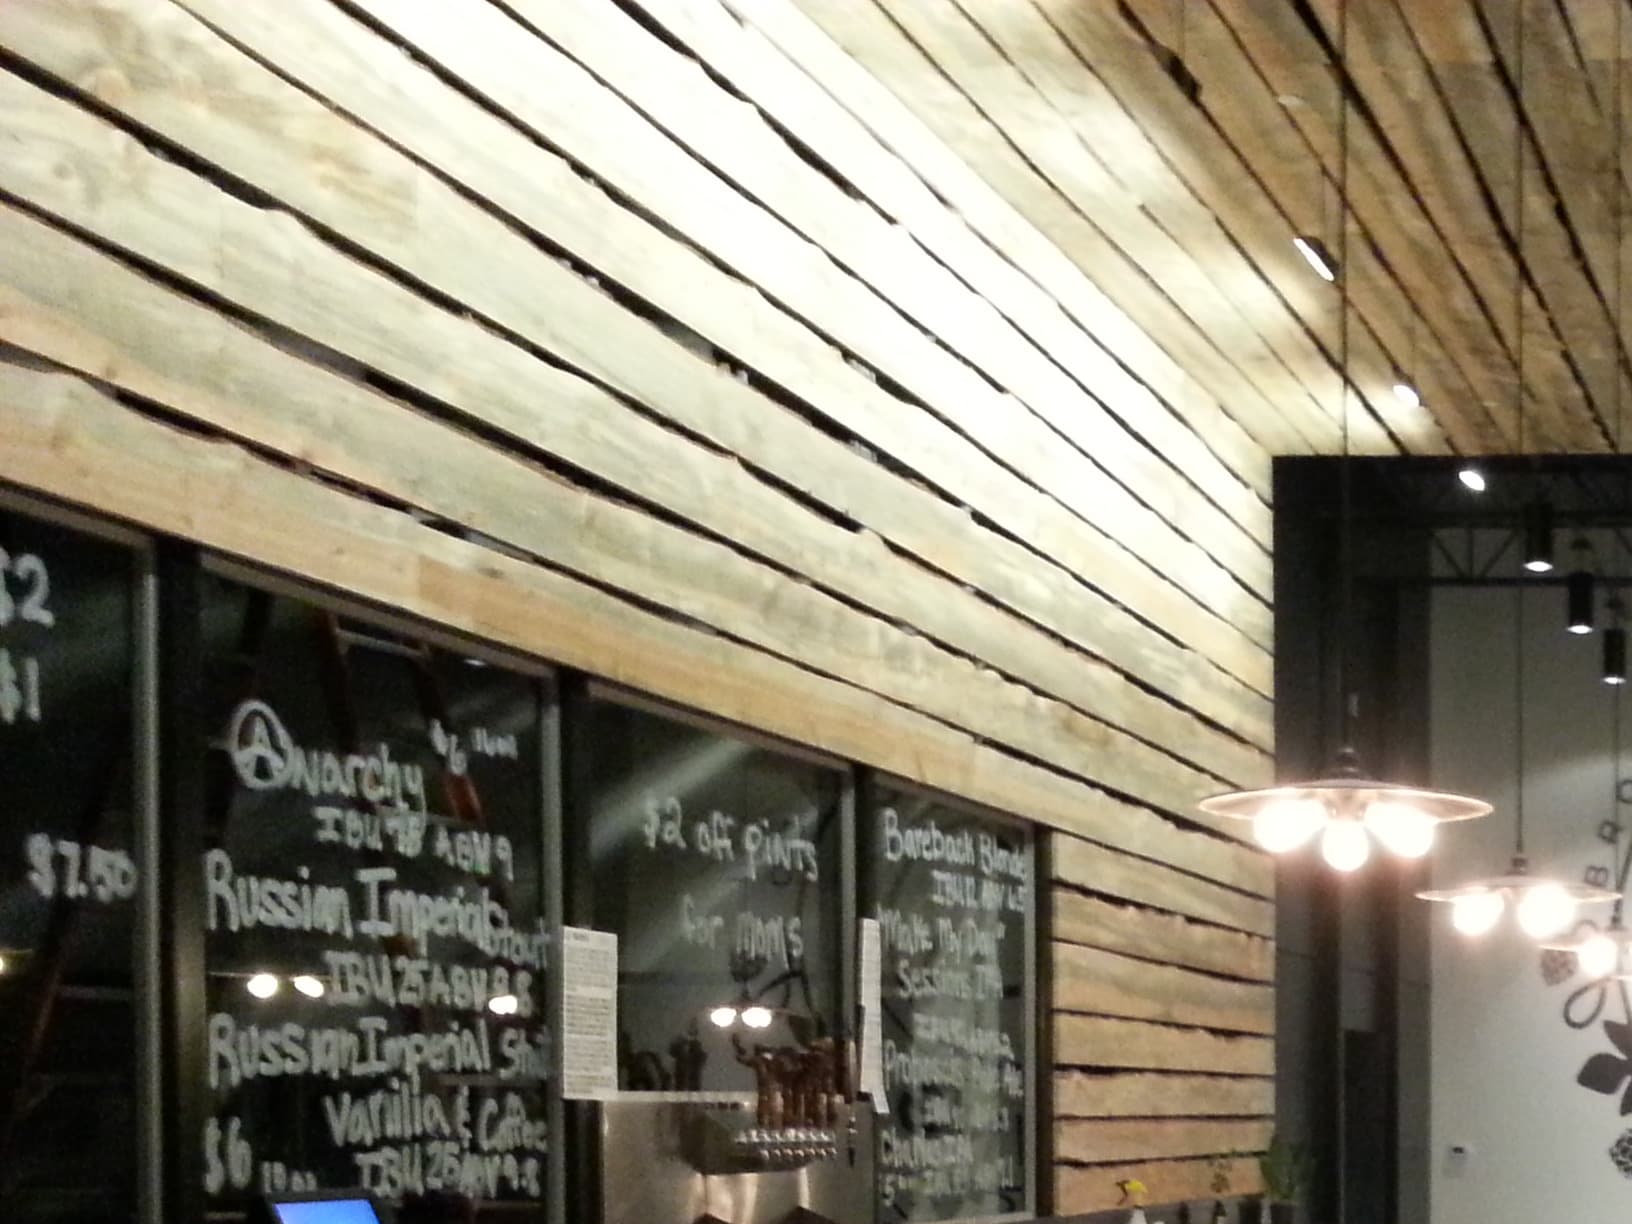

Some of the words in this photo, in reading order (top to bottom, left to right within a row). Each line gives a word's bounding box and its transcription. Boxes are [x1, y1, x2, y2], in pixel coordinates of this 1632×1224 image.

[204, 849, 353, 940] Russian
[325, 951, 396, 1007] IBU
[208, 1012, 358, 1090] Russian
[325, 1077, 450, 1147] Vanilla
